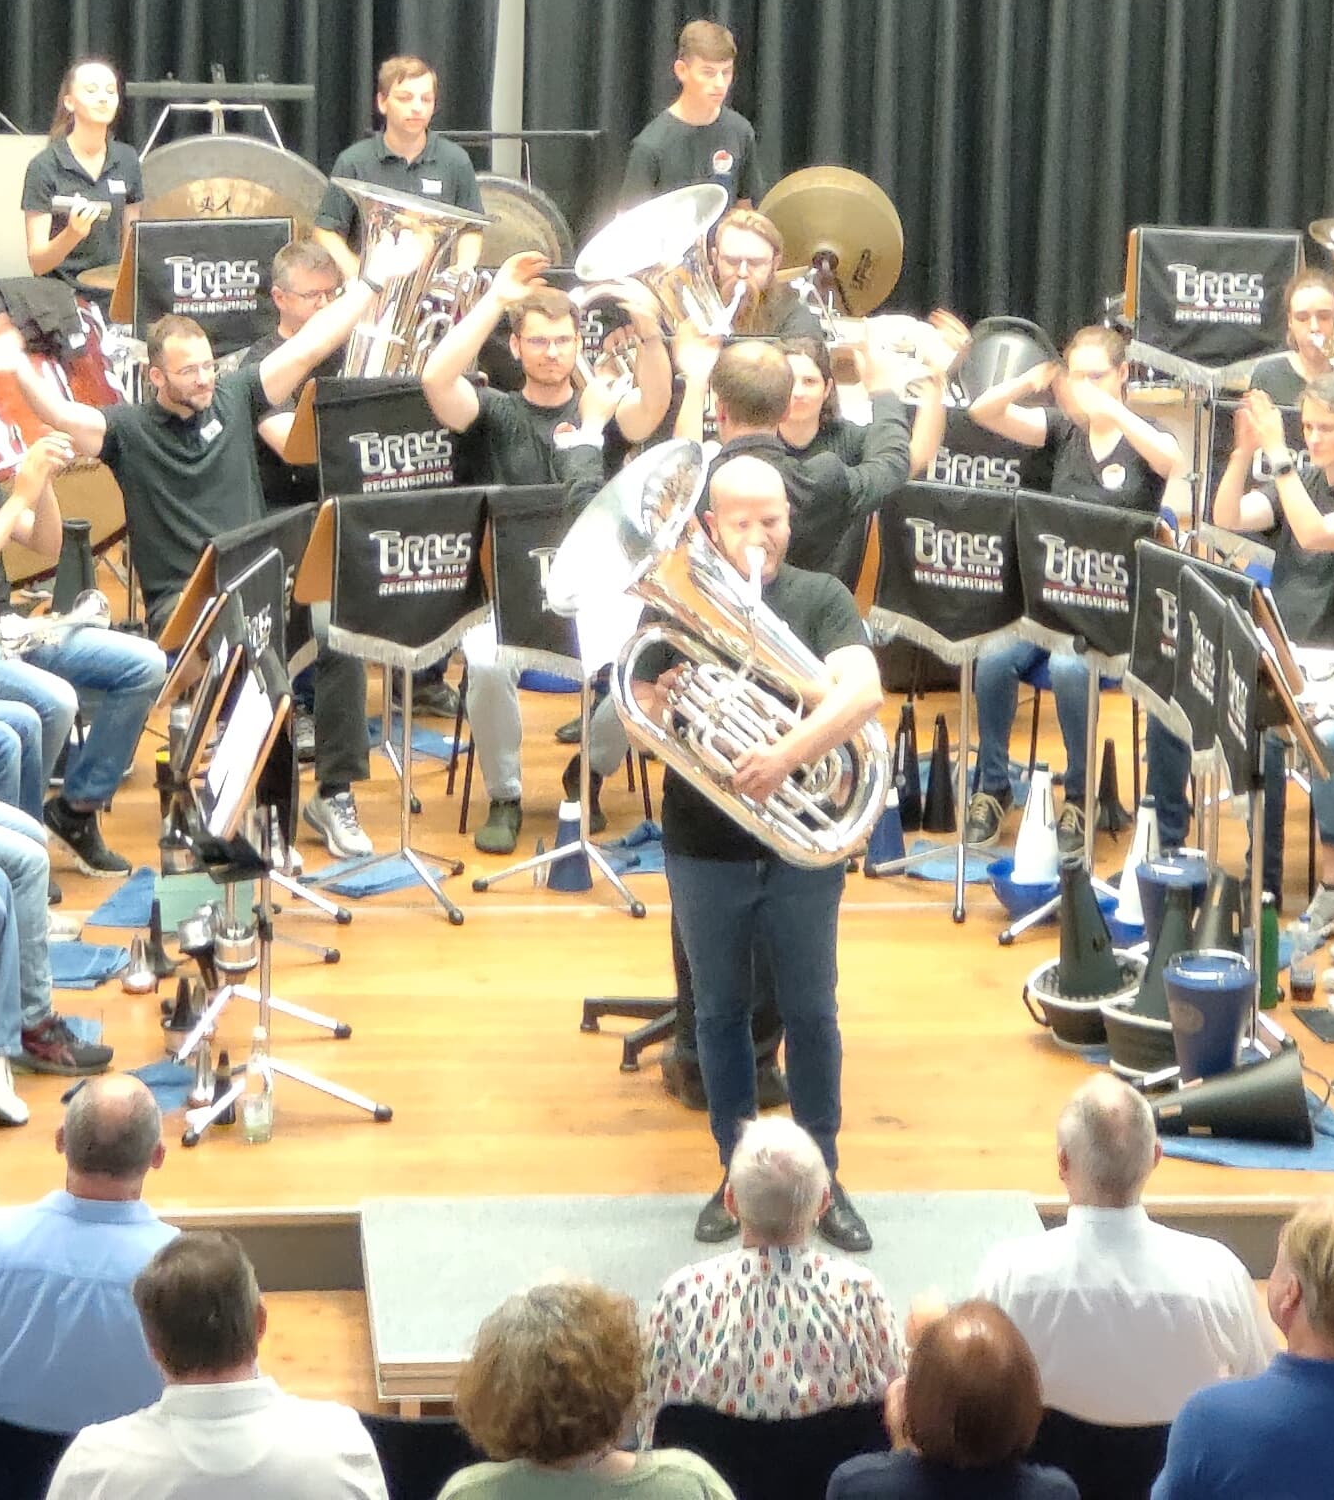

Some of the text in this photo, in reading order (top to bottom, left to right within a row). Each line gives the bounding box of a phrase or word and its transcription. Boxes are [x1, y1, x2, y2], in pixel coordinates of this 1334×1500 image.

[164, 255, 260, 299] BRASS
[1167, 263, 1264, 308] BRASS
[349, 428, 452, 475] BRASS
[926, 446, 1021, 487] BRASS
[362, 471, 454, 493] REGENSBURG
[369, 530, 472, 577] BRASS
[906, 518, 1003, 571] BRASS
[1038, 534, 1129, 589] BRASS
